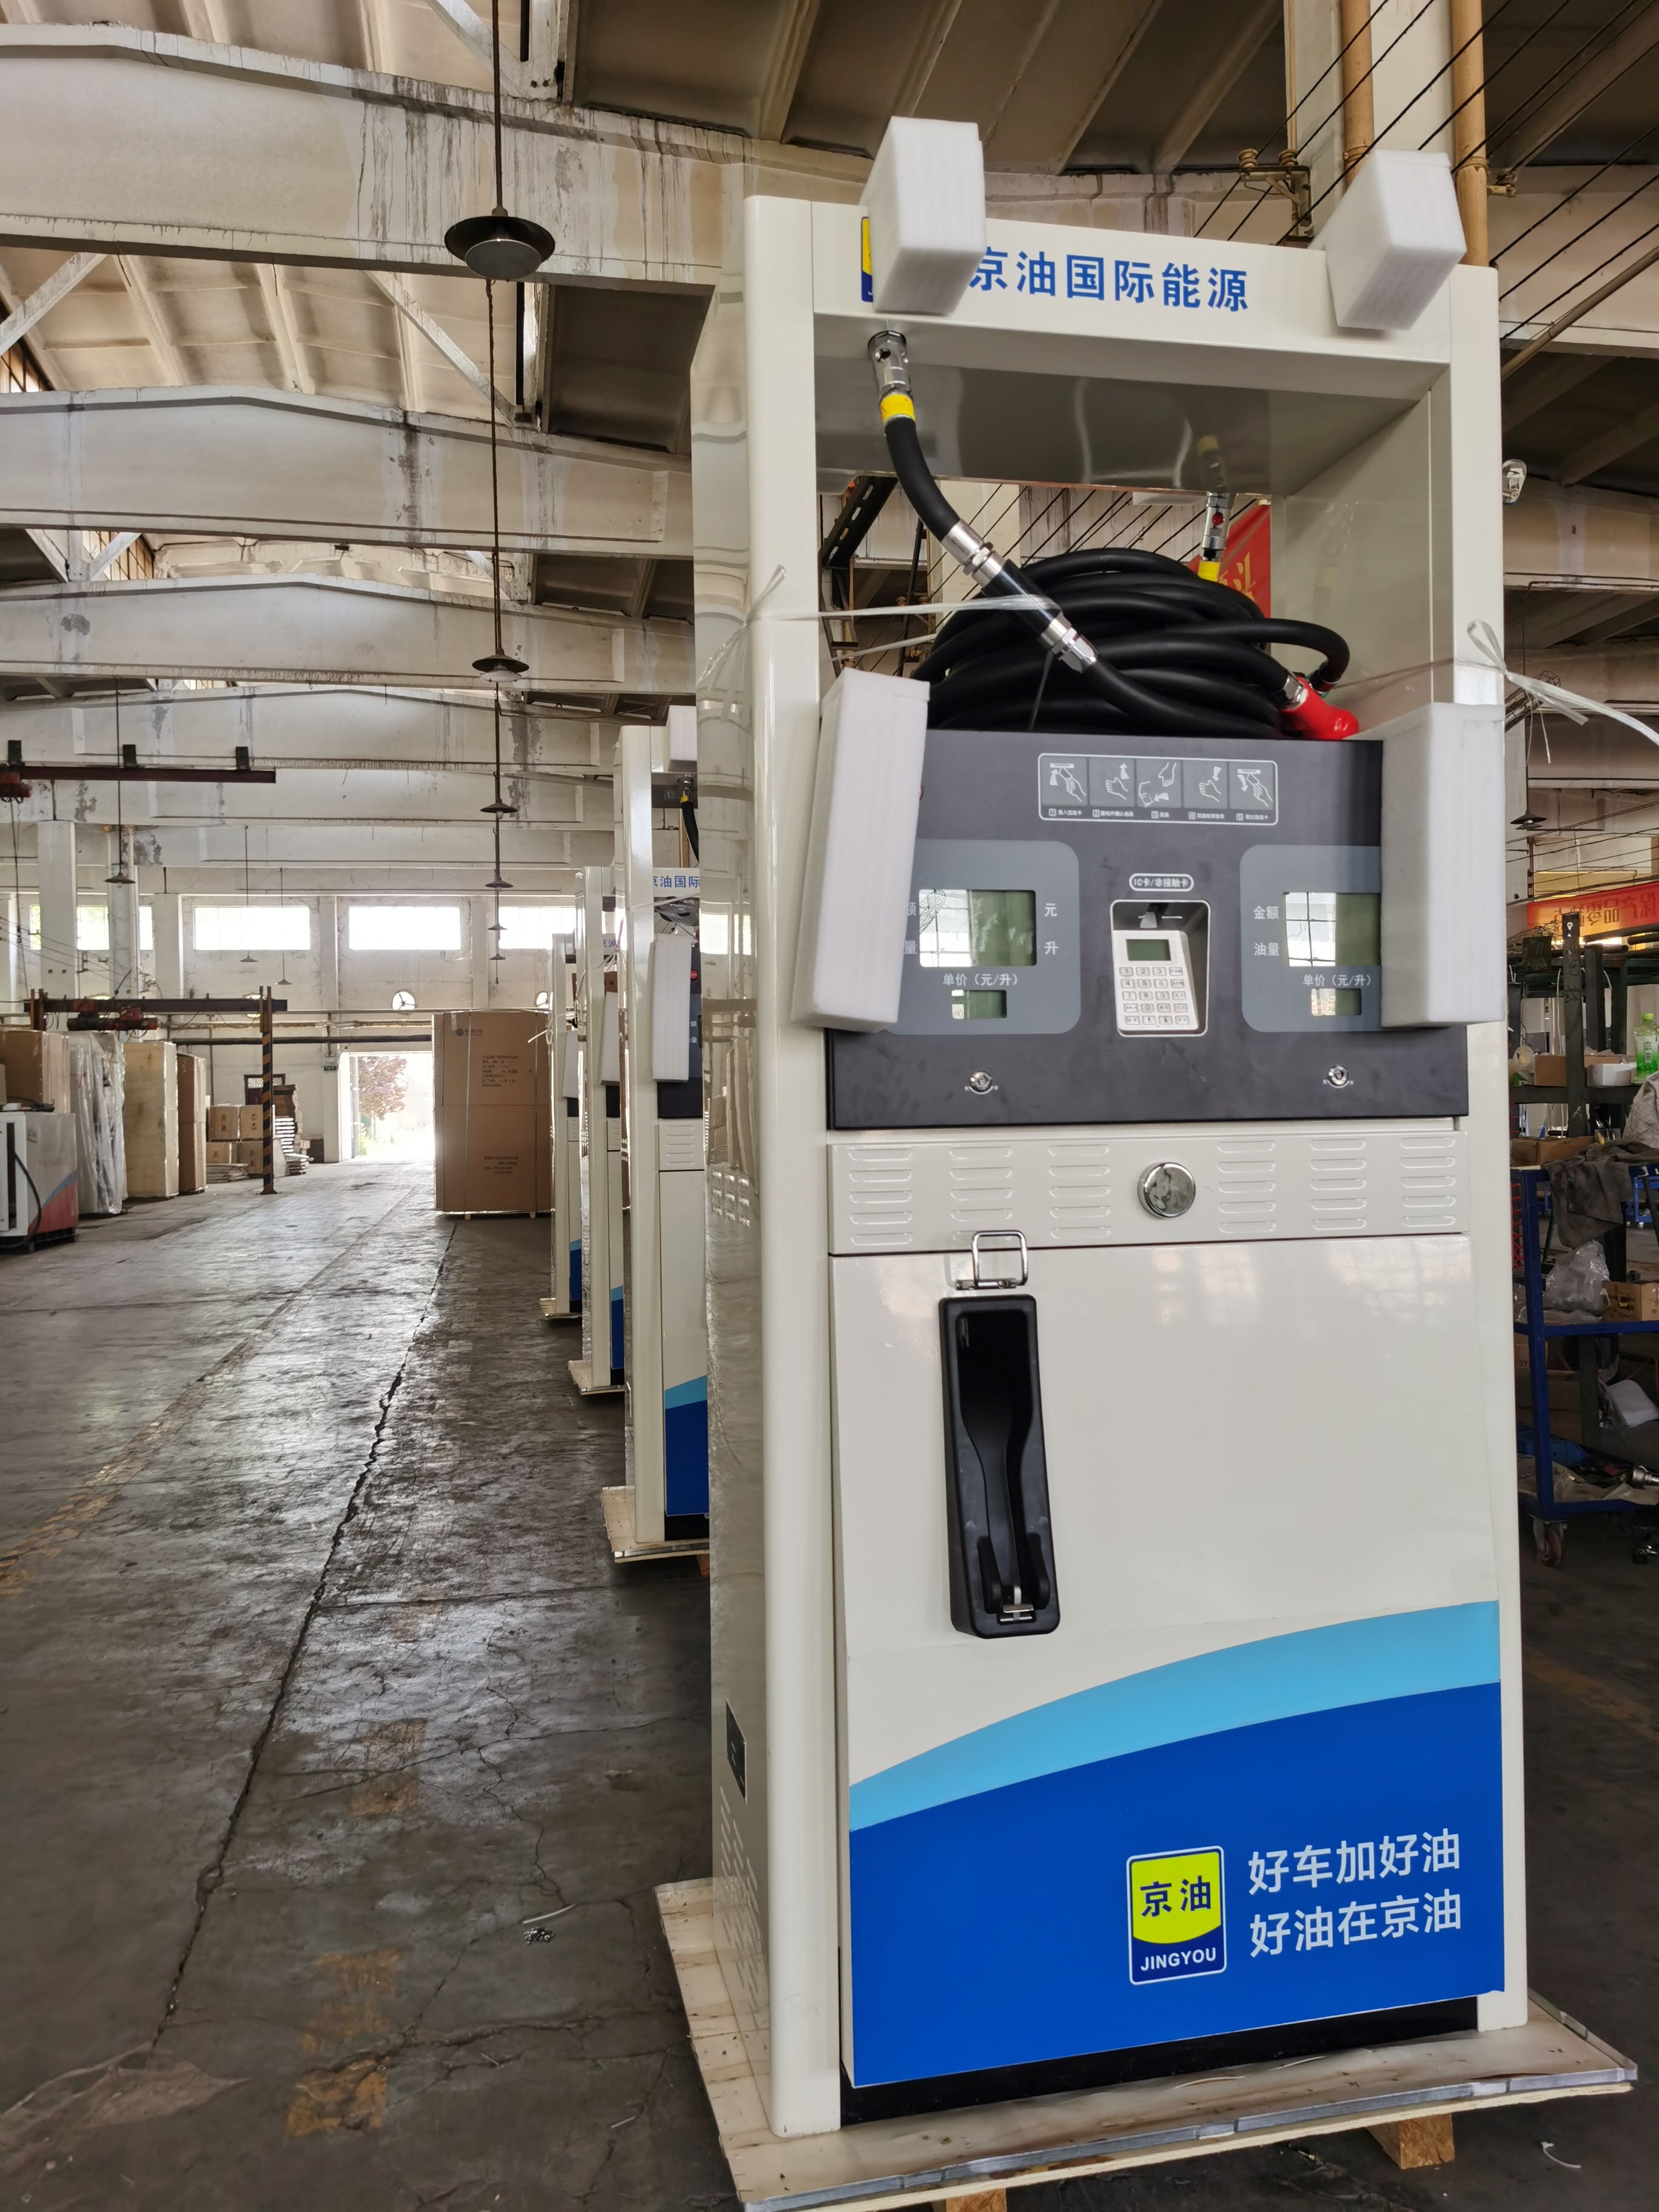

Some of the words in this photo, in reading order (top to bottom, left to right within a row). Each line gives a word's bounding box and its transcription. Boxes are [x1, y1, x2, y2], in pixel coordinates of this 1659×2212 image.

[970, 246, 1249, 312] 京油国际能源
[1044, 903, 1057, 917] 元
[1253, 905, 1279, 919] 金额
[1044, 941, 1059, 955] 升
[1254, 942, 1280, 956] 油量
[1248, 1828, 1460, 1895] 好车加好油
[1140, 1875, 1212, 1917] 京油
[1250, 1888, 1461, 1957] 好油在京油
[1140, 1947, 1216, 1971] JINGYOU
